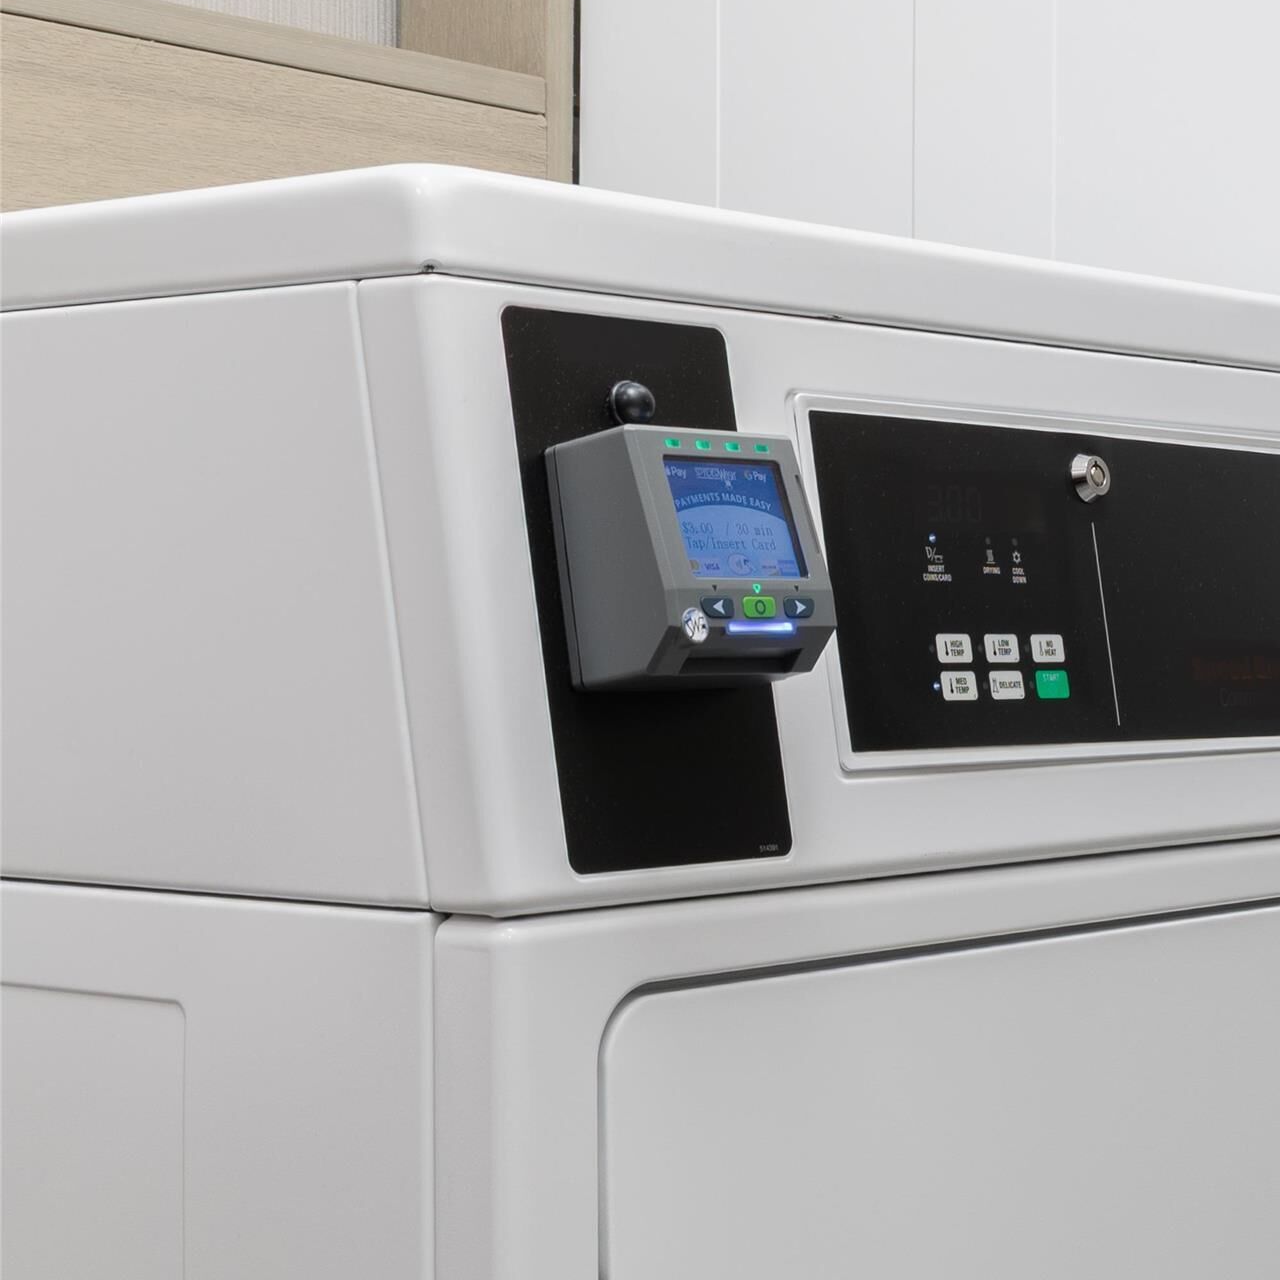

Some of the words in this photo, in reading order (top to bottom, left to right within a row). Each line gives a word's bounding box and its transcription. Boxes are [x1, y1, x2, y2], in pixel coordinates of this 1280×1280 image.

[675, 492, 720, 509] PAYMENTS
[721, 493, 747, 505] MADE
[750, 497, 772, 511] EASY
[682, 521, 714, 535] $3.00
[754, 524, 773, 536] min
[686, 537, 747, 551] Tap/Insert
[752, 538, 777, 551] Card
[949, 640, 963, 648] HIGH
[997, 648, 1012, 656] TEMP
[955, 677, 968, 685] MED
[998, 681, 1022, 689] DELICATE
[955, 686, 970, 694] TEMP
